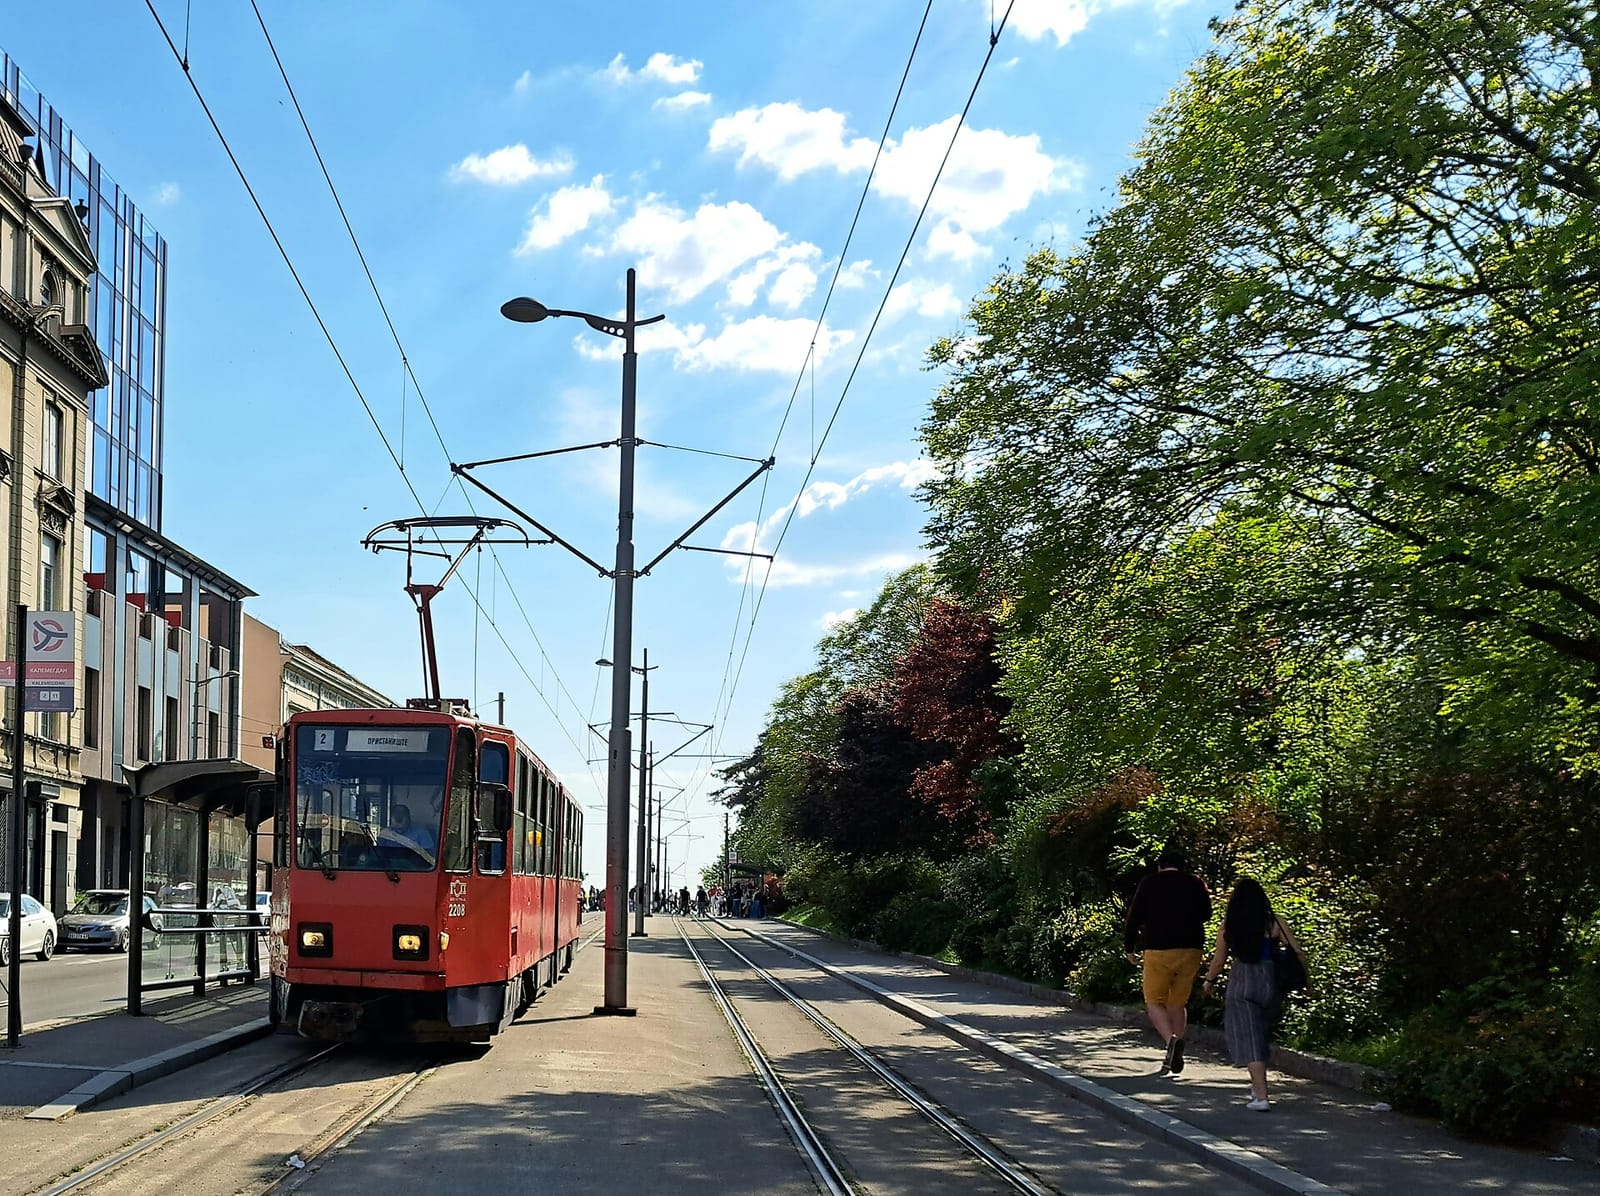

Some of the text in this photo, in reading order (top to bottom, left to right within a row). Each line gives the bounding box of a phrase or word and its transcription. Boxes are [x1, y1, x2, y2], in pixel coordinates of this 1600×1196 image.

[320, 733, 326, 744] 2
[367, 737, 408, 746] ПРИСТАНИШТЕ
[448, 903, 466, 917] 2208
